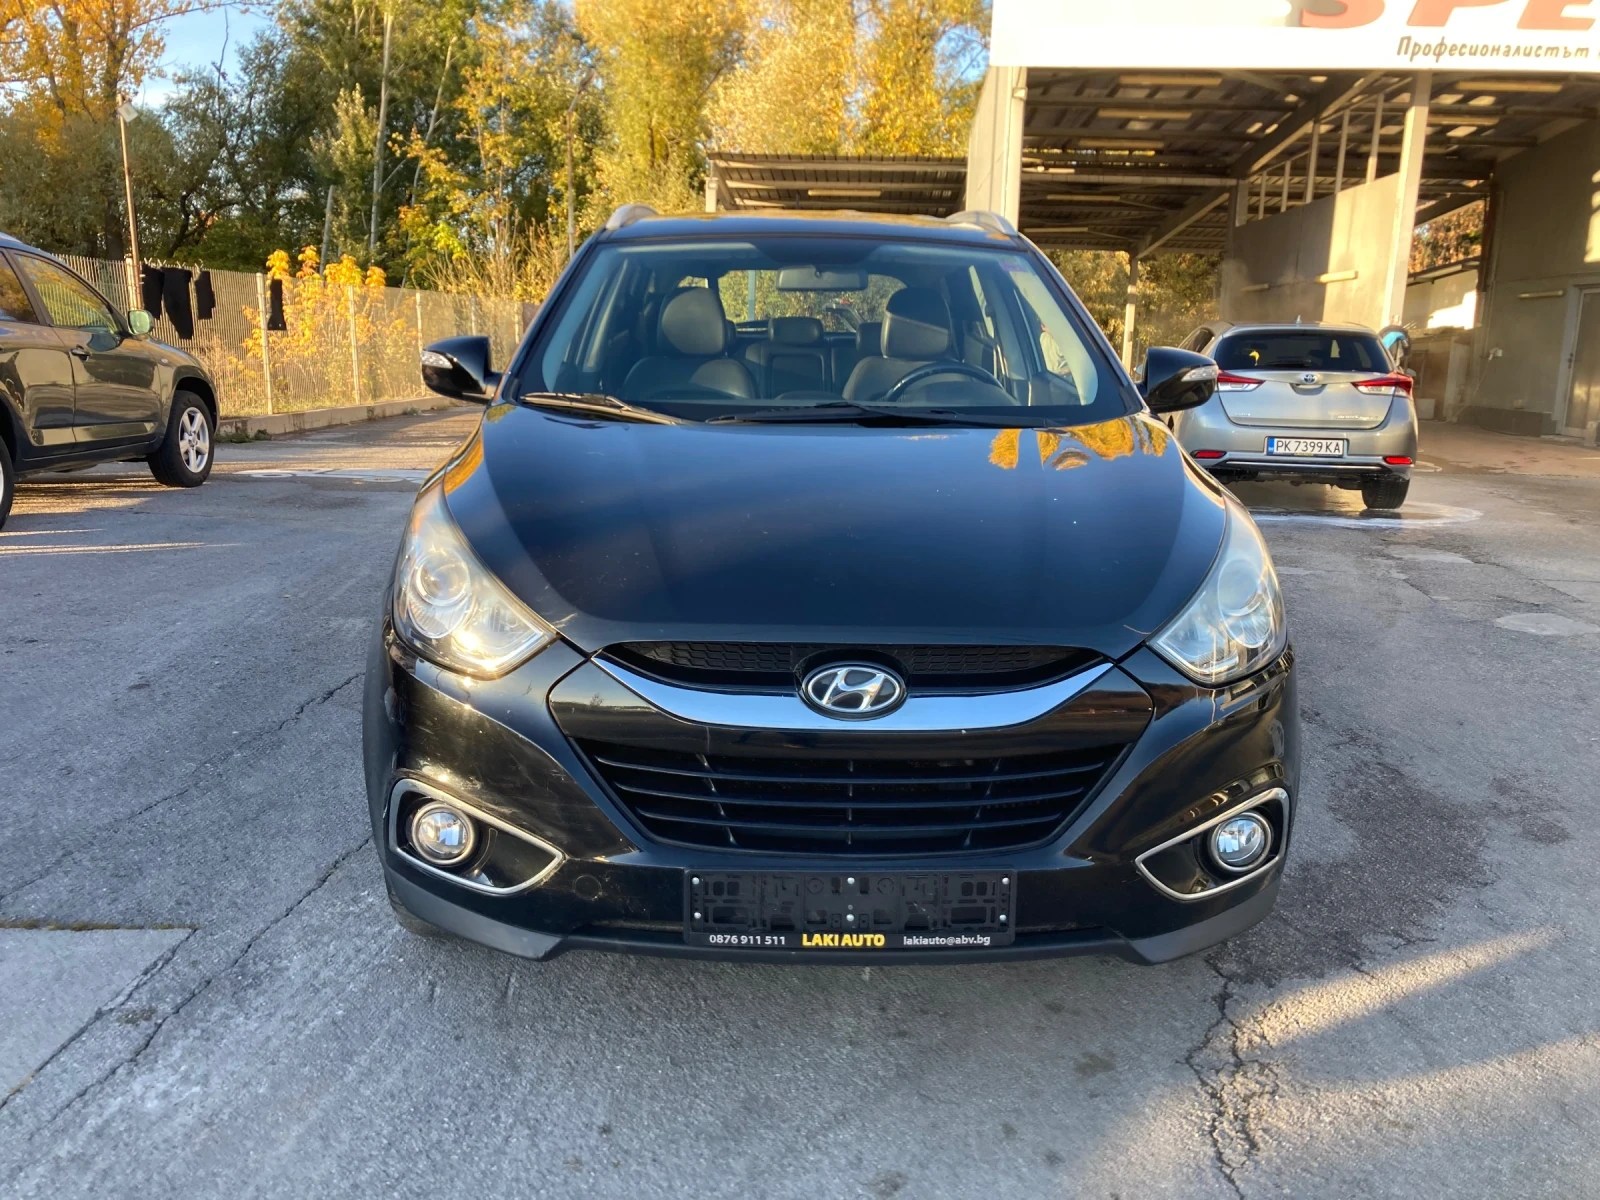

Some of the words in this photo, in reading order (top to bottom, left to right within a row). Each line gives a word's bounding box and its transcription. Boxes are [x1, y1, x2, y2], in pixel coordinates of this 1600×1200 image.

[1396, 35, 1590, 63] Професионалистът
[709, 934, 738, 944] 0876
[740, 935, 761, 945] 911
[764, 936, 785, 945] 511
[802, 933, 839, 946] LAKI
[841, 933, 885, 947] AUTO
[903, 935, 991, 946] lakiauto@abv.bg
